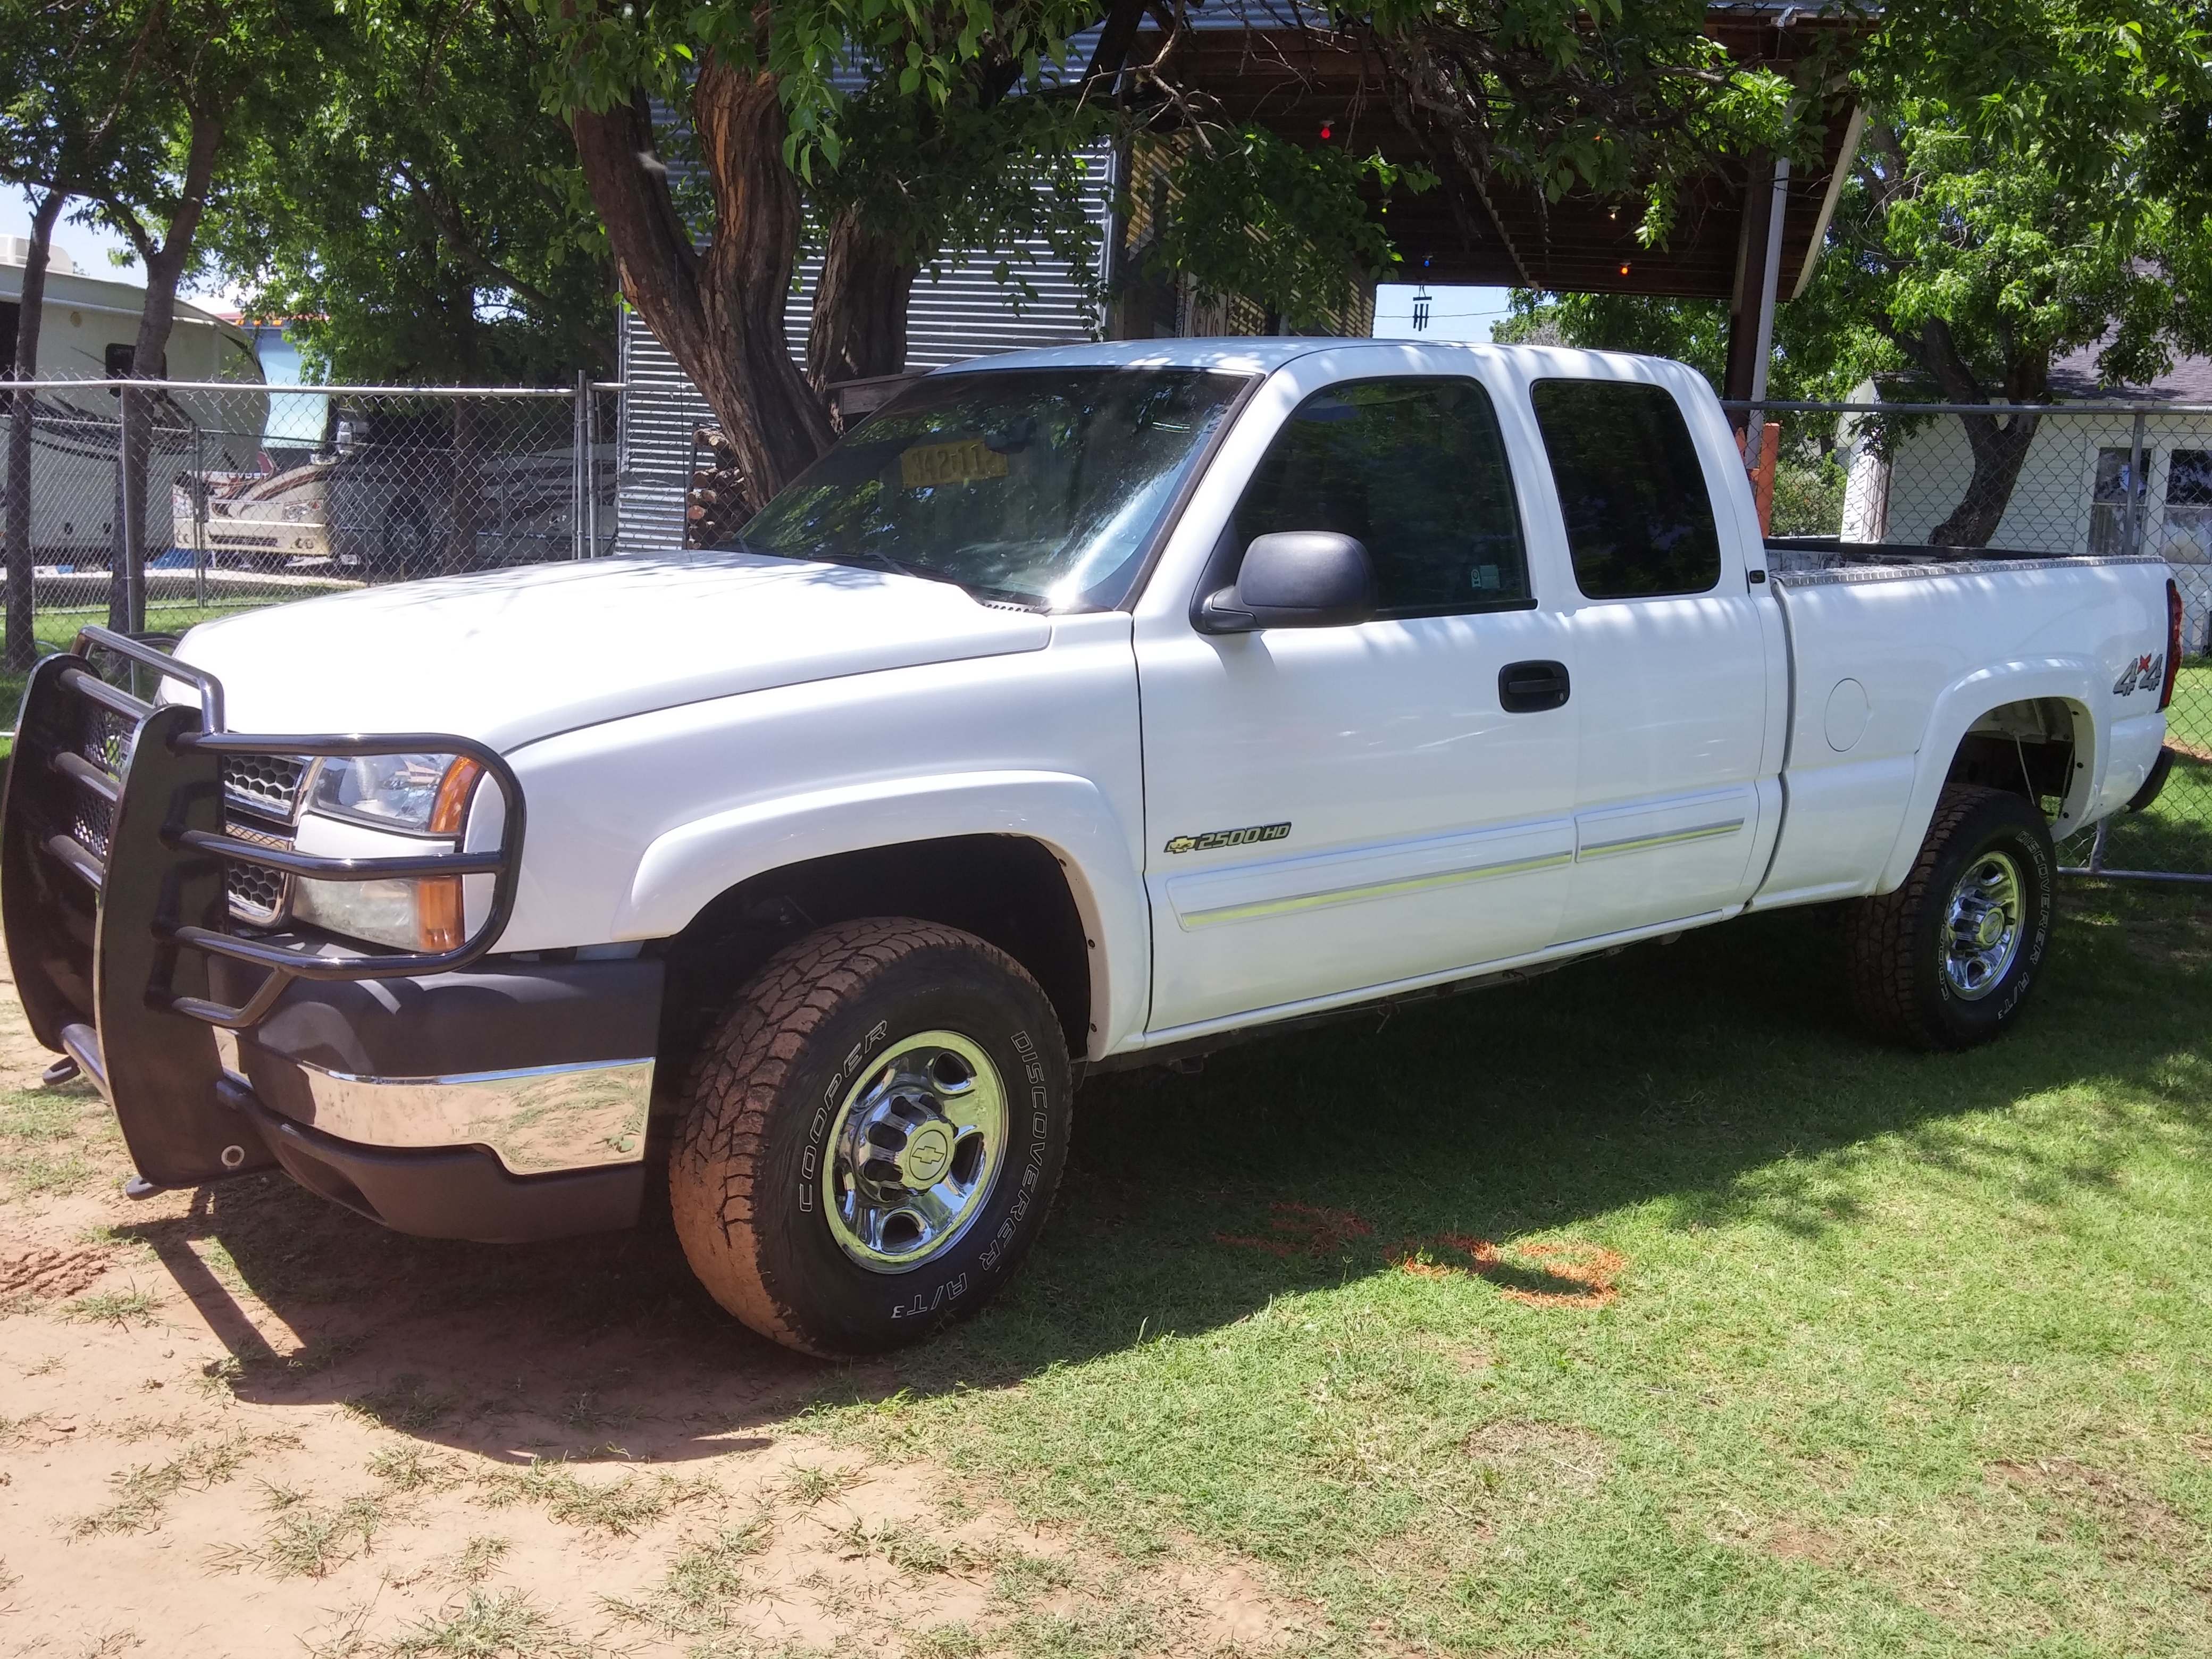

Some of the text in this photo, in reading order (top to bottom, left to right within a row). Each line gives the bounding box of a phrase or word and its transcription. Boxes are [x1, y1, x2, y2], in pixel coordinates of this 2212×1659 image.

[1197, 825, 1290, 850] 2500 HD
[2015, 831, 2051, 965] DISCOVERER
[799, 1019, 888, 1213] COOPER
[979, 1030, 1048, 1272] DISCOVERER
